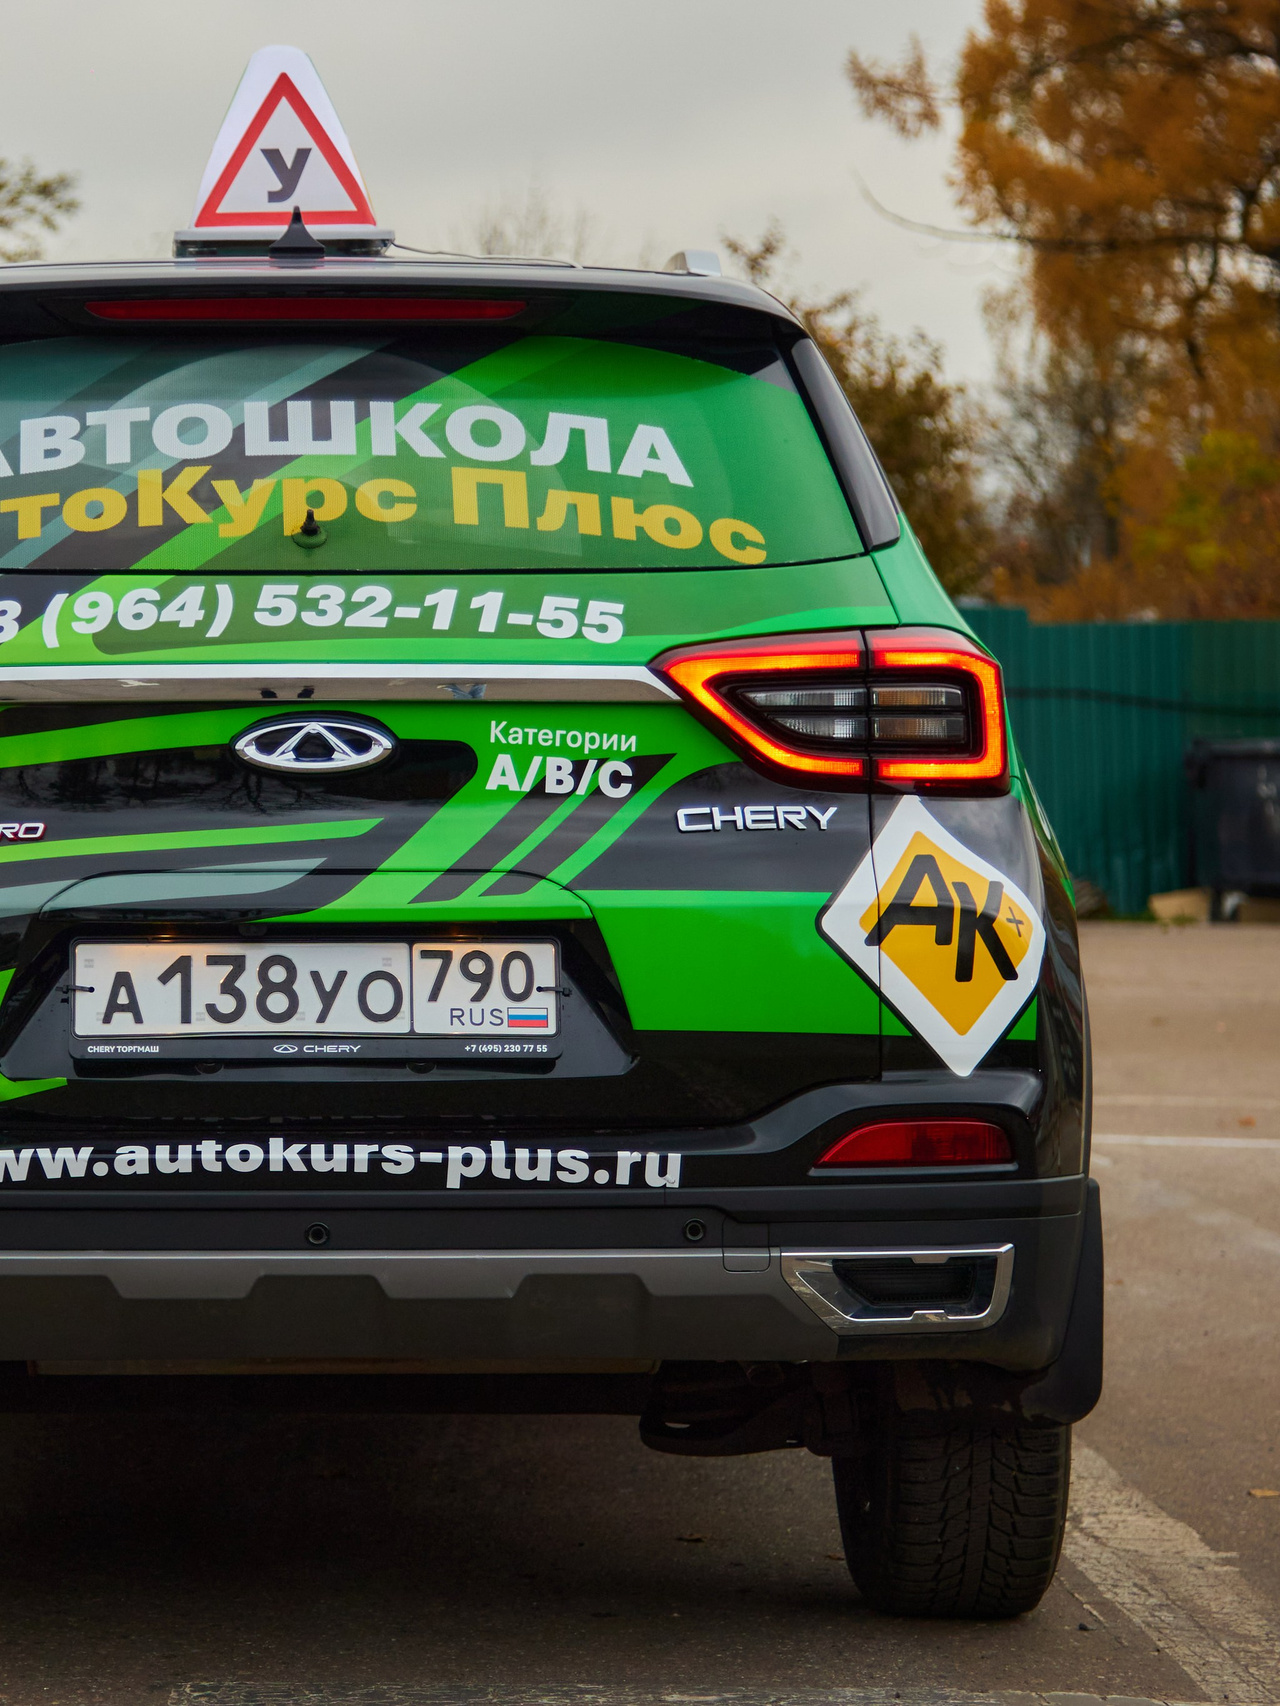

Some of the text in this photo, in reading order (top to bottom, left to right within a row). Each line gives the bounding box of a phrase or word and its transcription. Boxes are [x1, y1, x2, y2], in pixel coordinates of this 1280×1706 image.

[451, 466, 767, 565] Плюс
[41, 584, 234, 649] (964)
[253, 584, 624, 644] 532-11-55
[489, 720, 637, 754] Категории
[676, 804, 839, 833] CHERY
[419, 949, 535, 1003] 790
[450, 1008, 504, 1027] RUS
[87, 1045, 160, 1053] CHERY ТОРГМАШ
[303, 1044, 361, 1053] CHERY
[464, 1044, 548, 1054] +7 (495) 230 77 55
